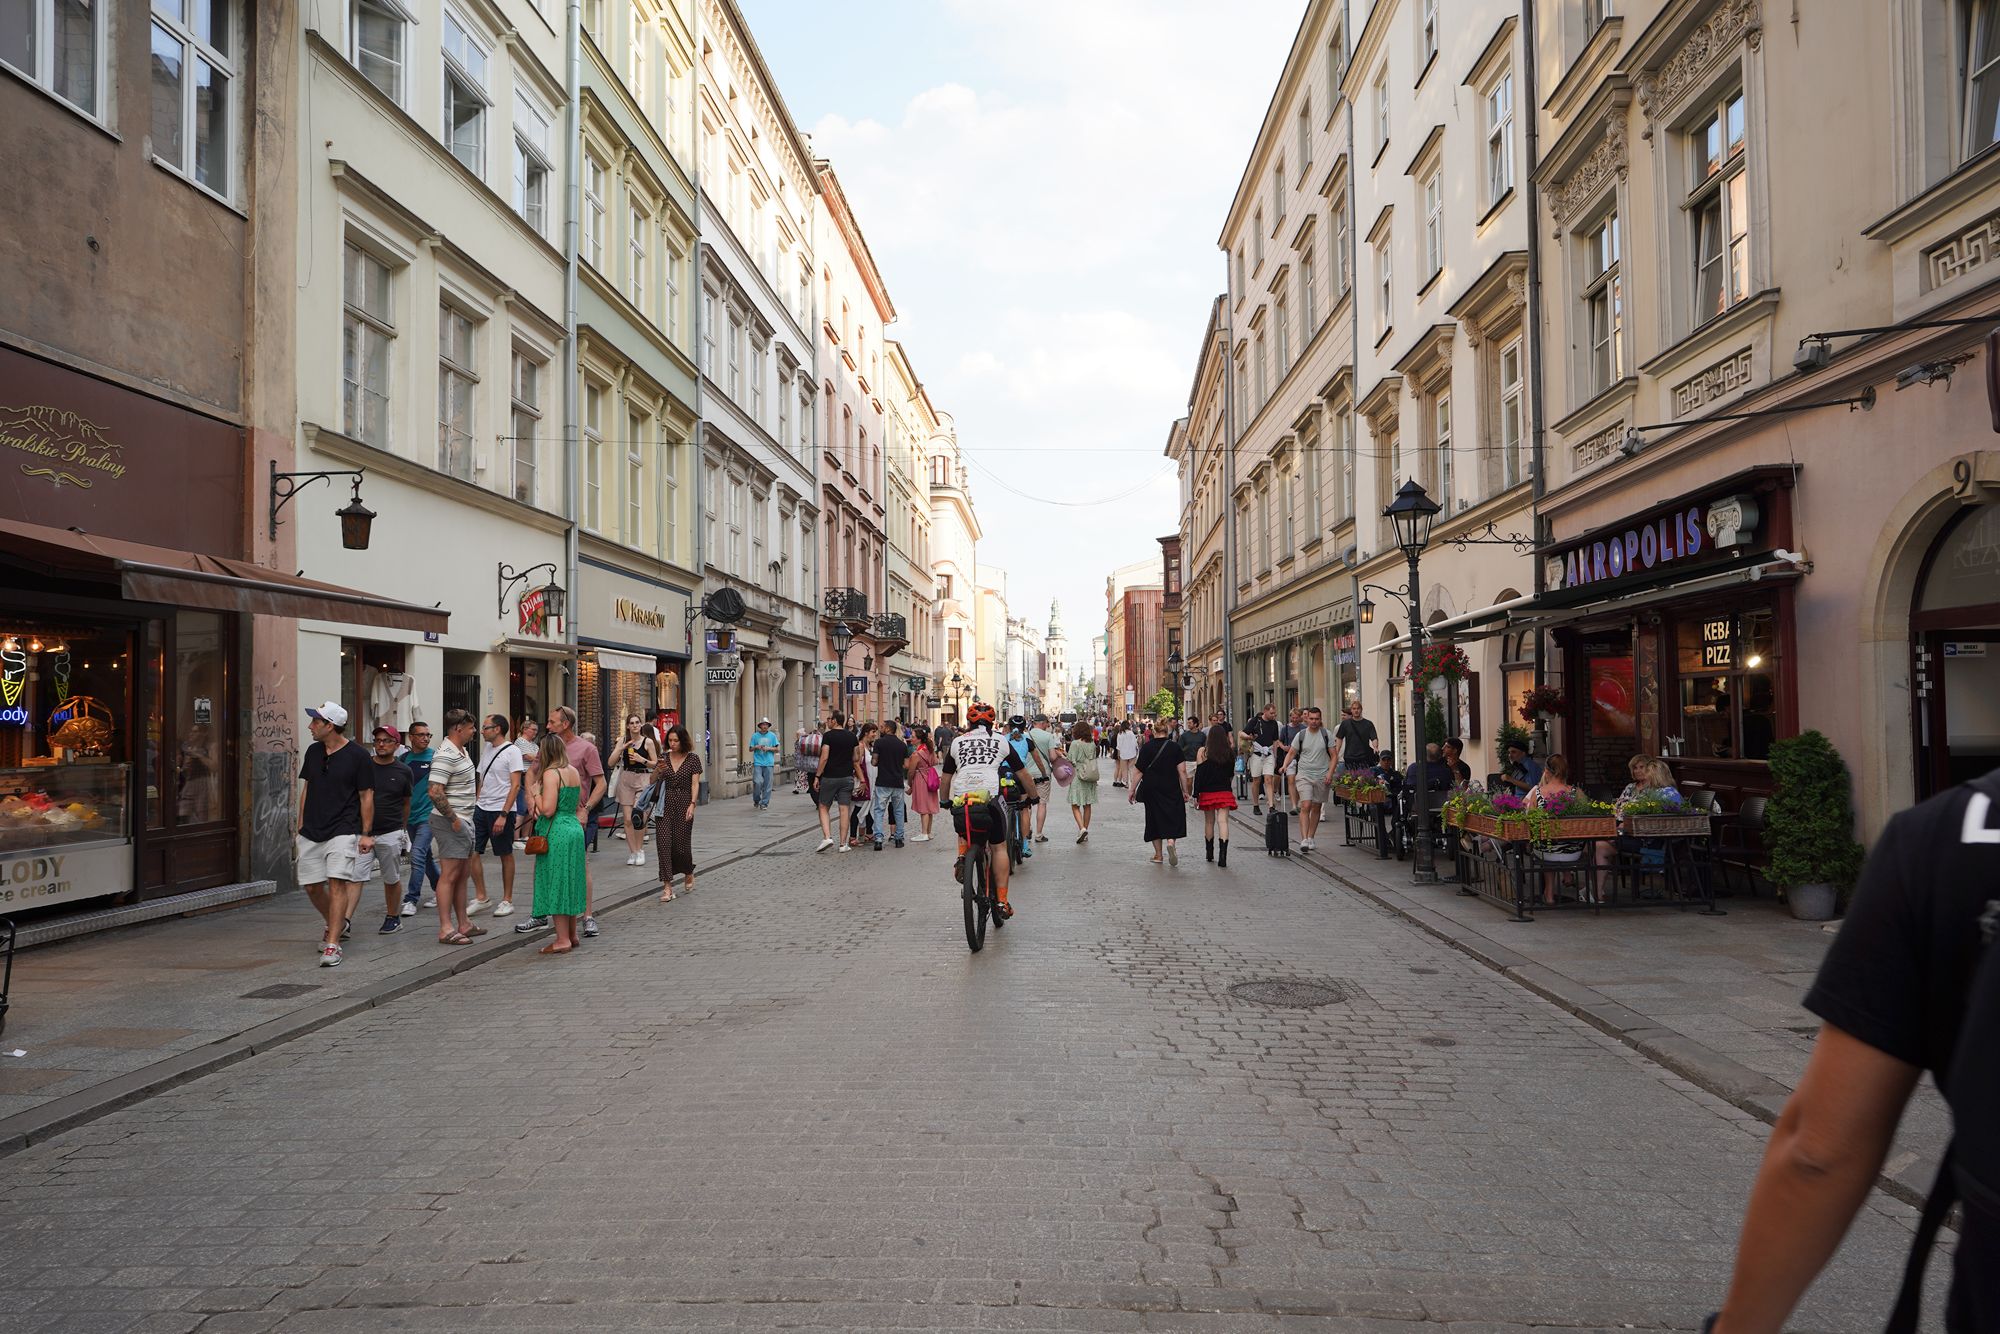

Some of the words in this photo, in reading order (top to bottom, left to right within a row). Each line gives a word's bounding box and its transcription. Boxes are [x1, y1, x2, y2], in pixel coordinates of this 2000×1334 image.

[61, 441, 126, 479] Praliny
[1952, 459, 1971, 495] 9
[1566, 507, 1702, 588] AKROPOLIS
[1704, 621, 1740, 641] KEBA
[1706, 645, 1731, 664] PIZZ
[708, 670, 736, 679] TATTOO
[0, 706, 28, 725] ody
[959, 755, 997, 769] 2017
[20, 881, 70, 899] cream
